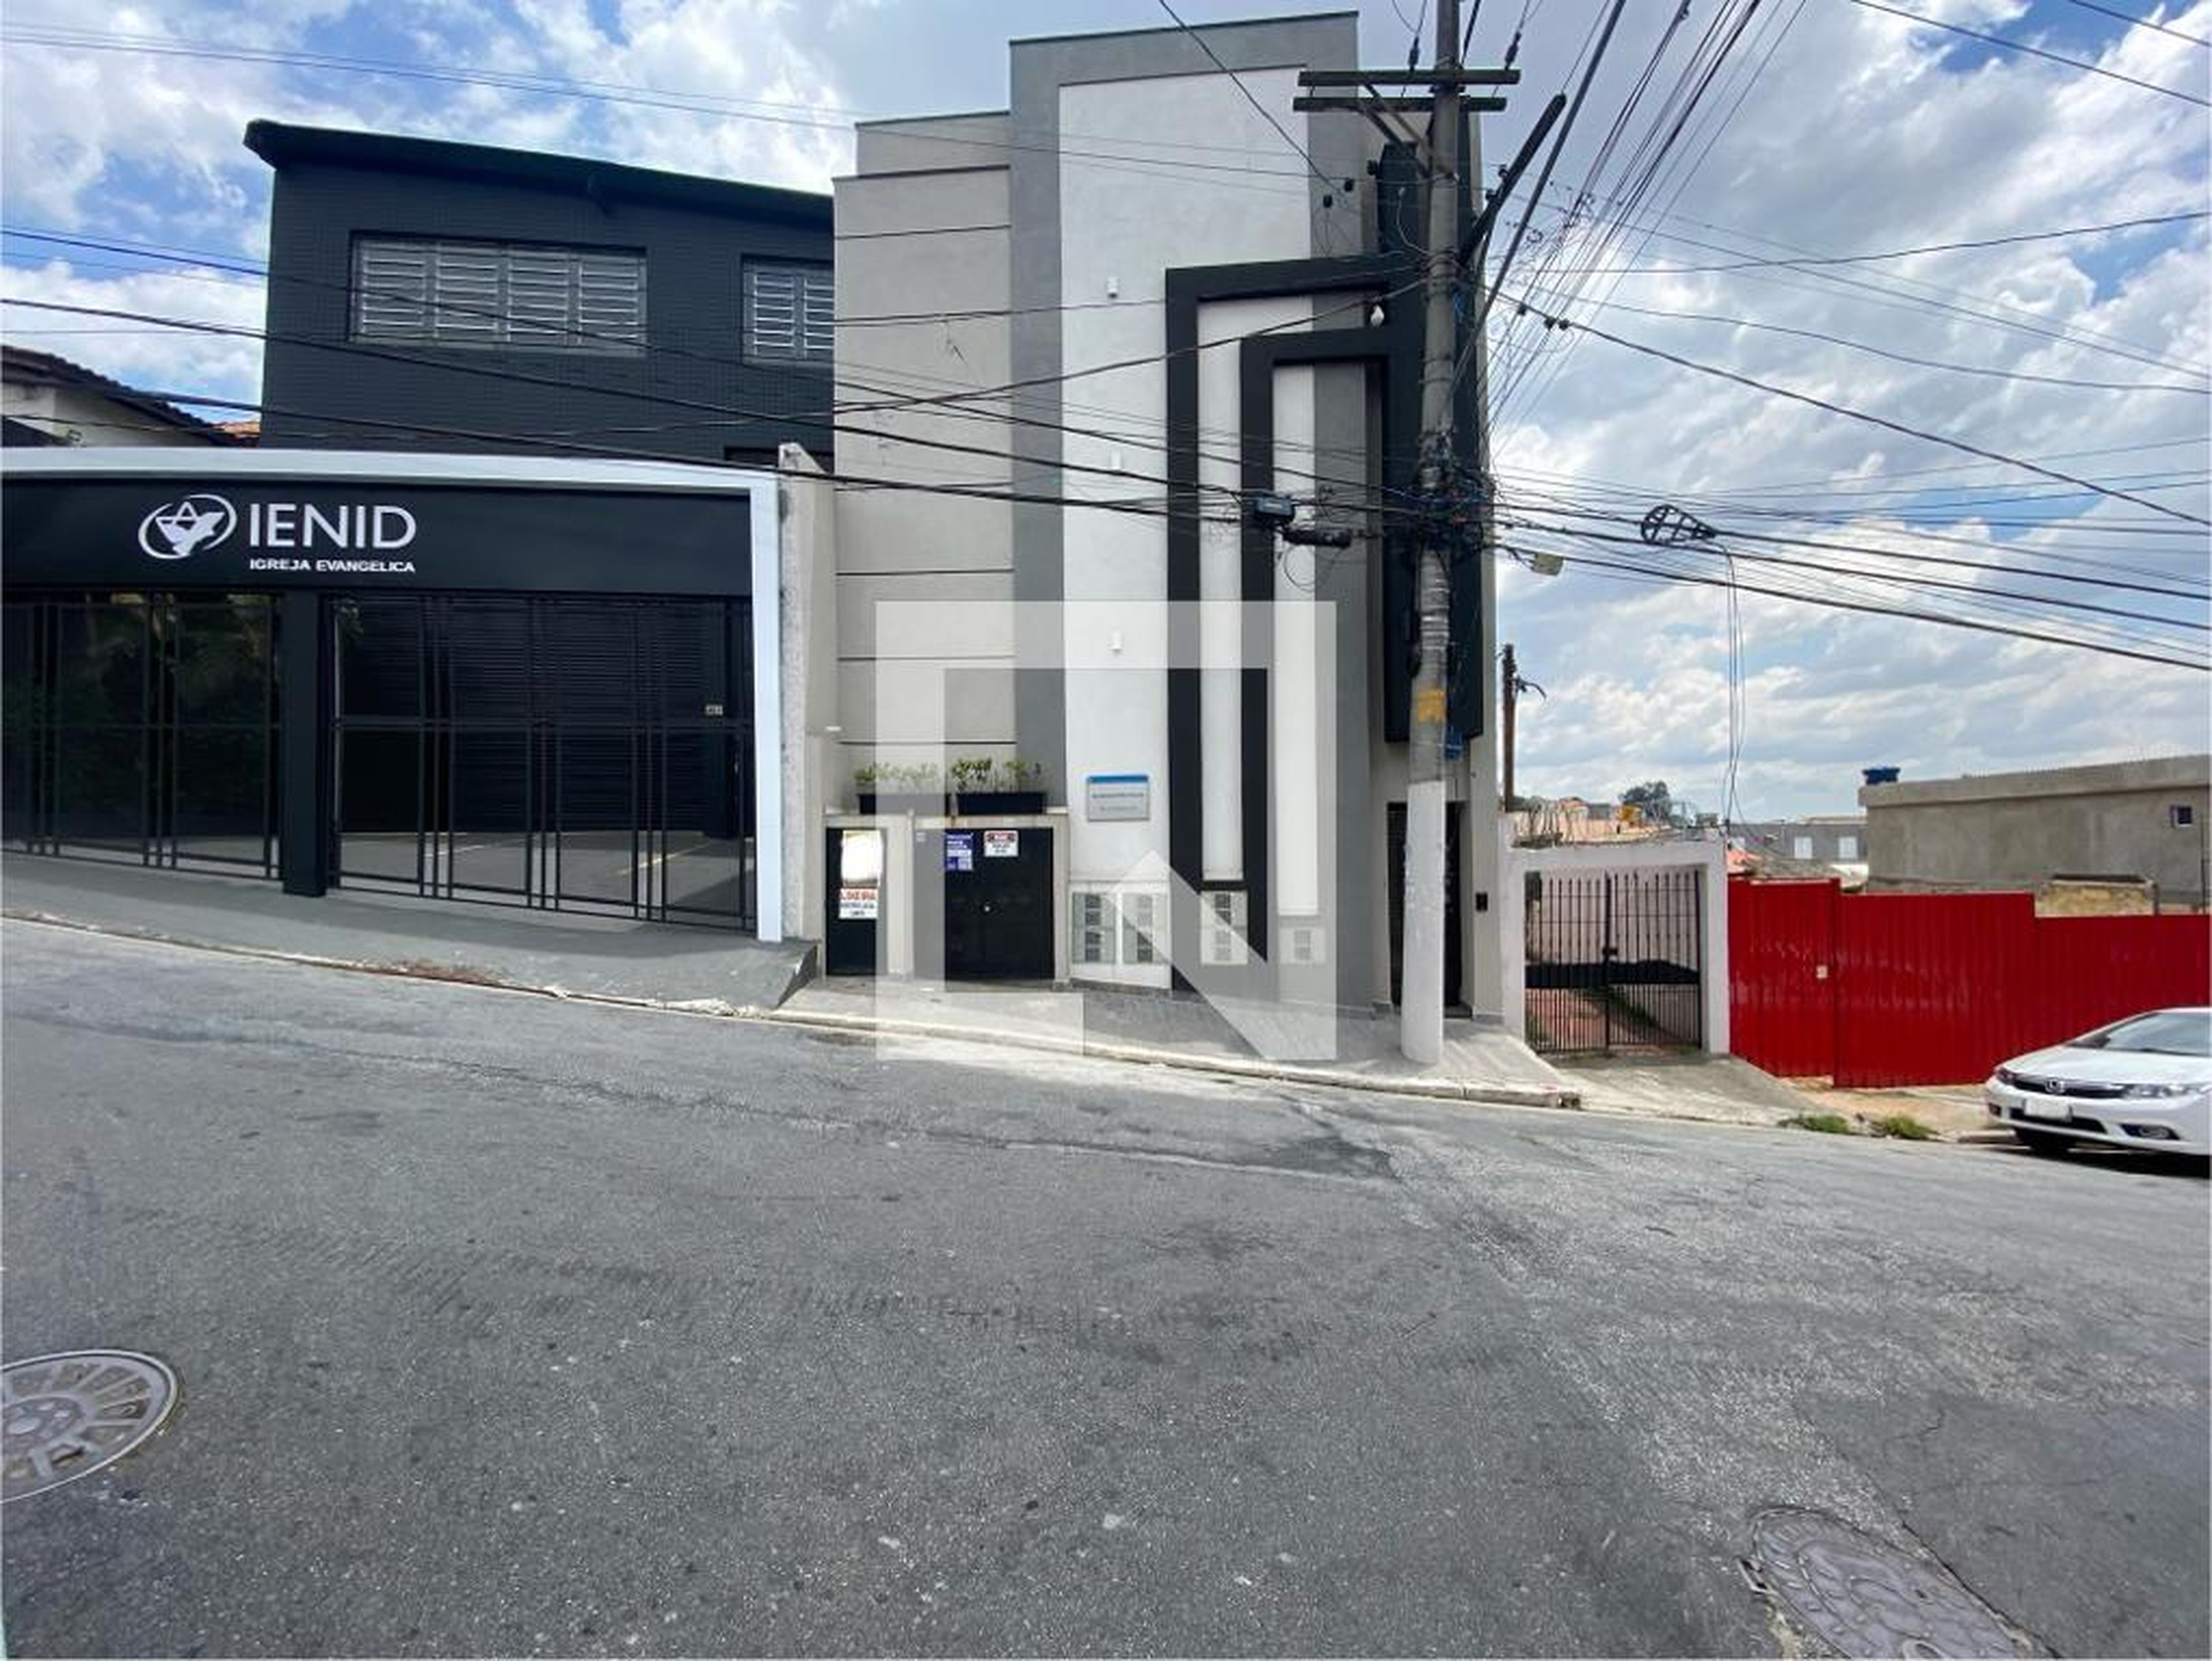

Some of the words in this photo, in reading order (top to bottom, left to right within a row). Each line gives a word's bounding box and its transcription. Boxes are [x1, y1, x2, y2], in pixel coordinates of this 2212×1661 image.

[249, 503, 416, 548] IENID
[249, 558, 311, 570] IGREJA
[316, 559, 415, 573] EVANGELICA
